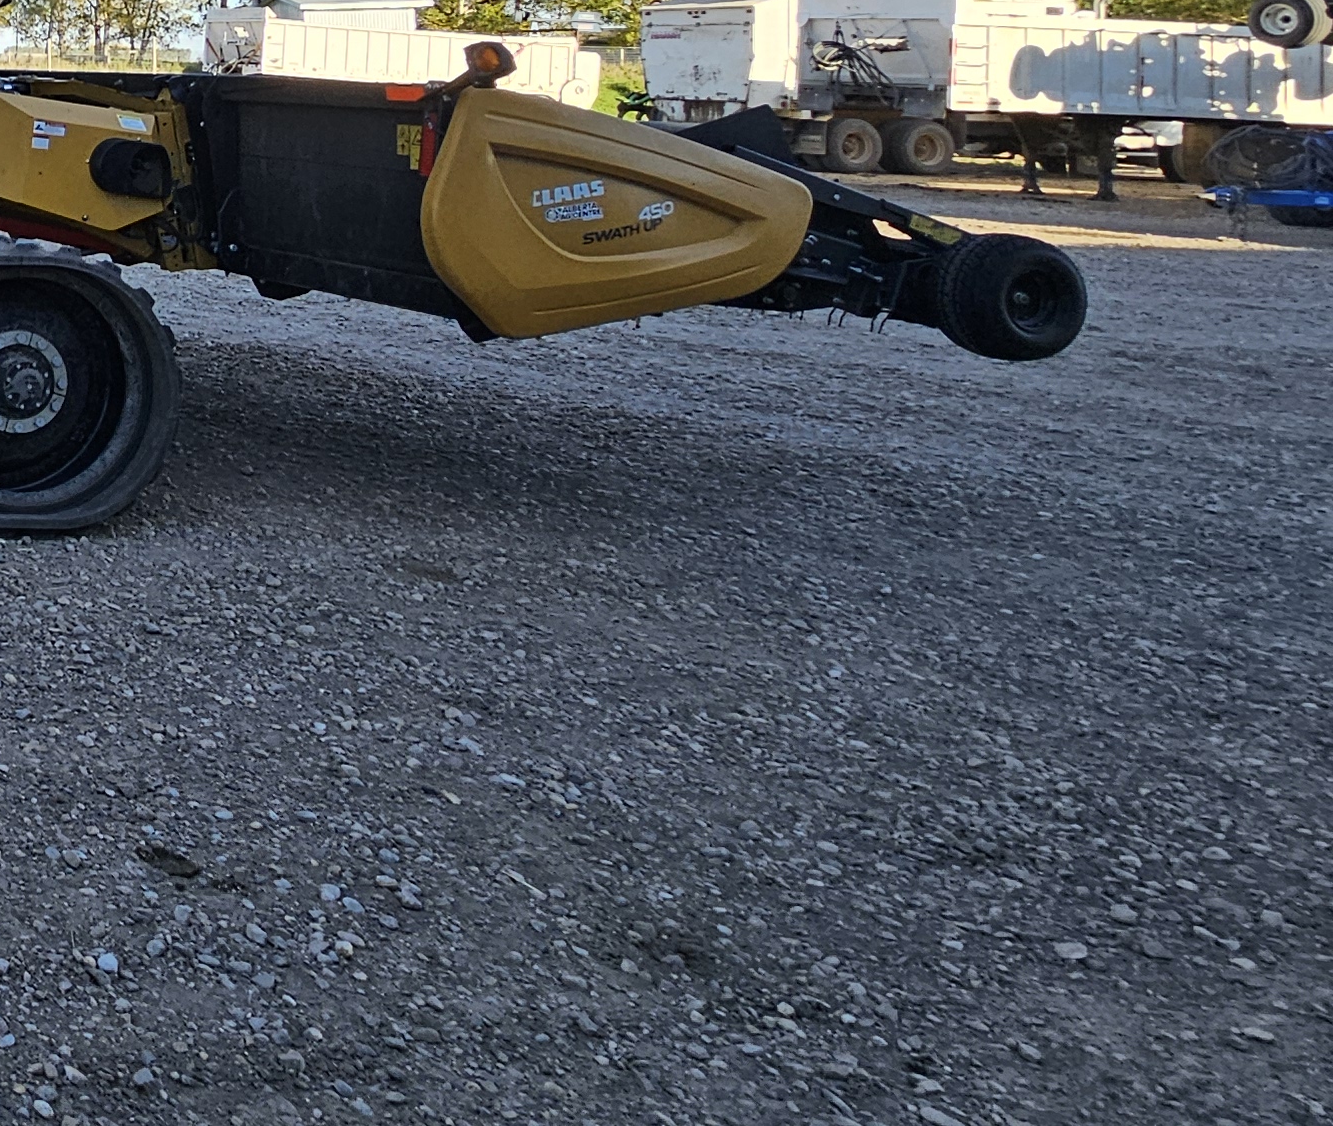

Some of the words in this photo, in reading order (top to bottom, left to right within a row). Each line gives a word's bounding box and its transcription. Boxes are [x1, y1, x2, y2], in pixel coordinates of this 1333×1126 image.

[531, 179, 606, 208] CLAAS
[562, 202, 598, 213] ALBERTA
[637, 200, 675, 221] 450
[582, 223, 641, 245] SWATH
[643, 217, 663, 233] UP
